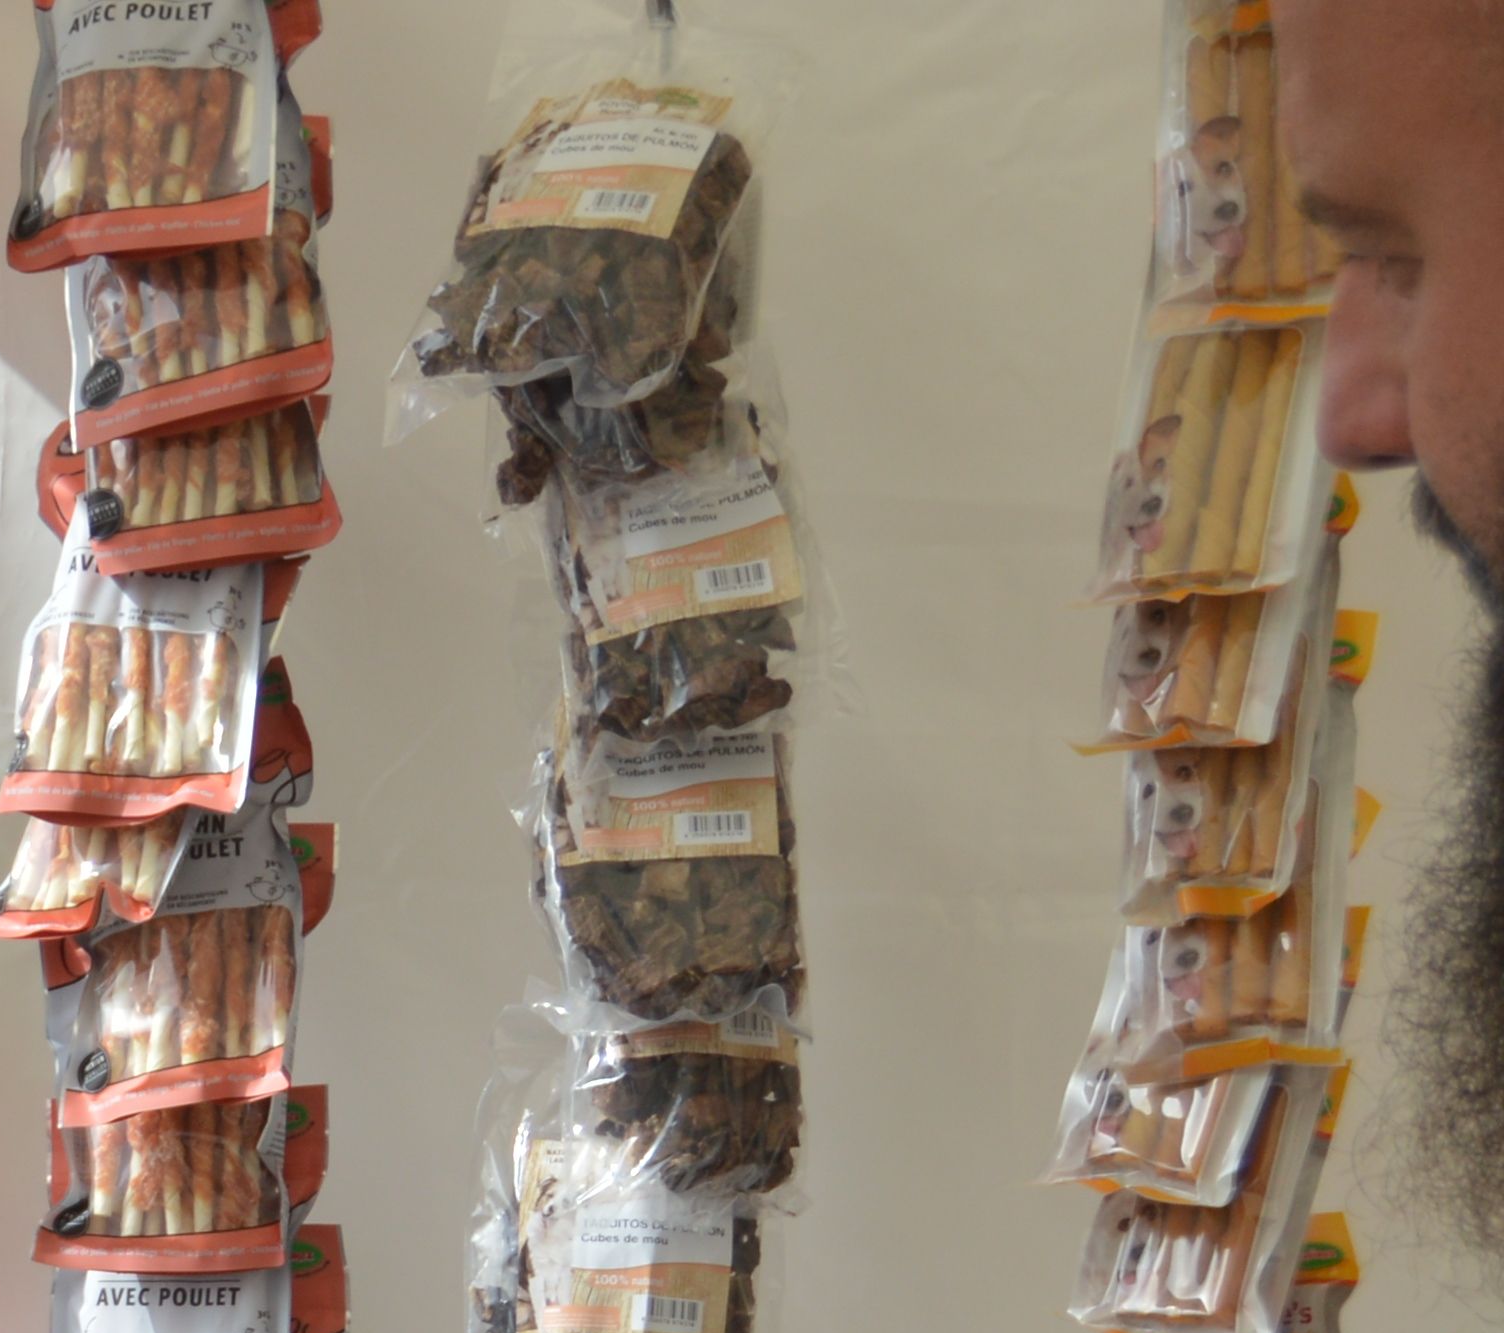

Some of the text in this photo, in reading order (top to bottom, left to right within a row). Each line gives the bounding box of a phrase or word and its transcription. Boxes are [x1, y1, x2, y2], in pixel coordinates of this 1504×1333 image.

[68, 1, 214, 36] AVEC POULET
[627, 511, 719, 533] Cubes de mou
[615, 760, 708, 778] Cubes de mou
[580, 1231, 670, 1246] Cubes de mou
[96, 1285, 242, 1307] AVEC POULET
